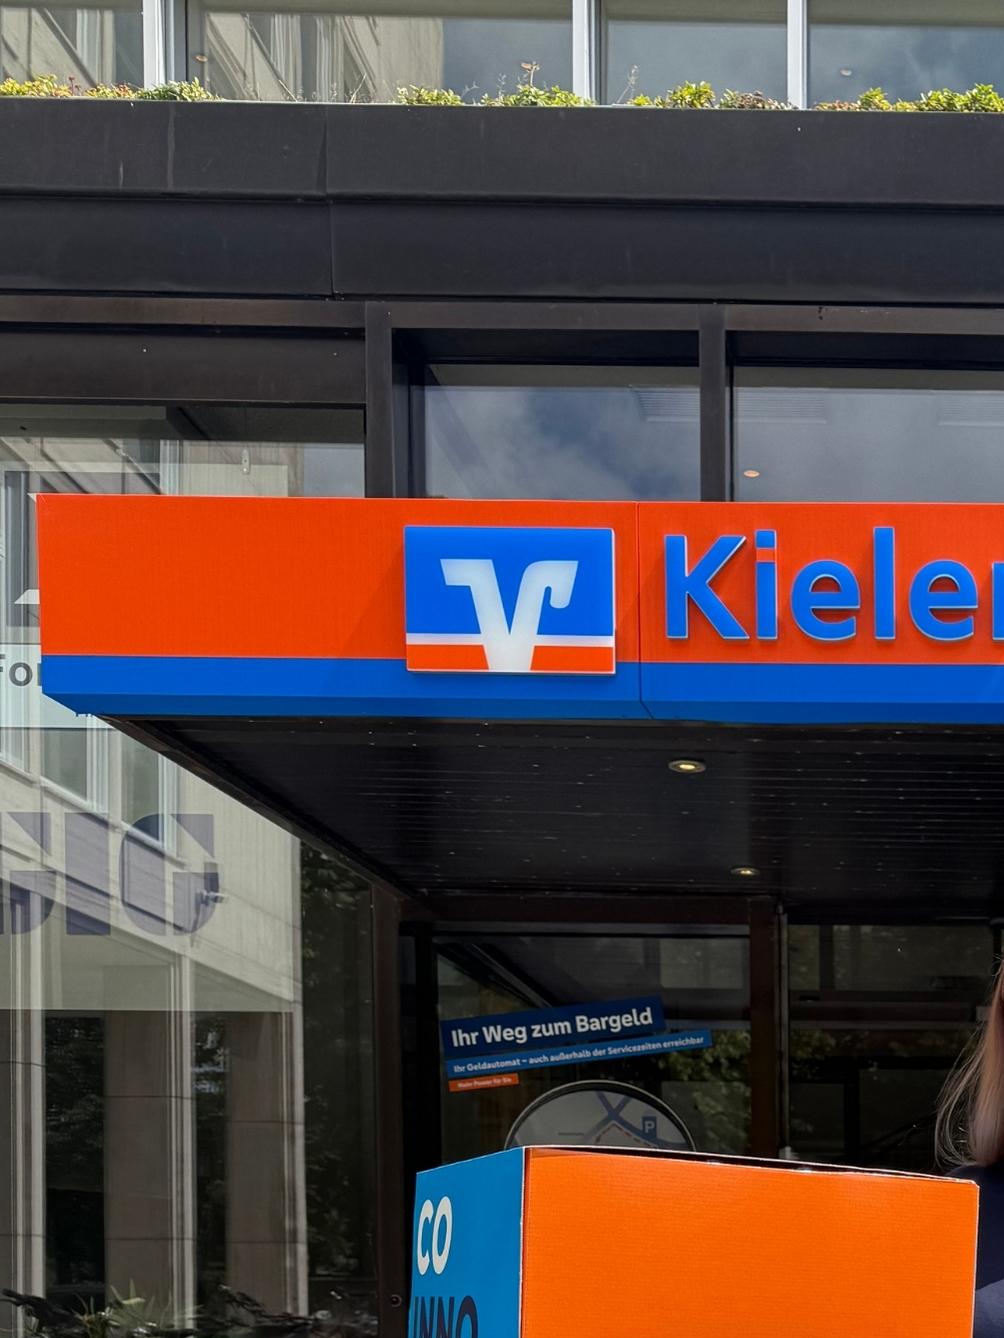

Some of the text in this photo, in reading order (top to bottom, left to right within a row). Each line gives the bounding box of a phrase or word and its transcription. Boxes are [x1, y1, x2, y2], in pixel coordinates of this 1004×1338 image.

[451, 1006, 654, 1048] Ihr Weg zum Bargeld
[453, 1065, 465, 1073] Ihr
[466, 1057, 521, 1072] Geldautomat
[529, 1055, 549, 1065] auch
[550, 1047, 591, 1062] außerhalb
[592, 1047, 606, 1057] der
[607, 1041, 662, 1055] Servicezeiten
[663, 1036, 704, 1049] erreichbar
[645, 1120, 655, 1133] P
[416, 1195, 453, 1275] CO
